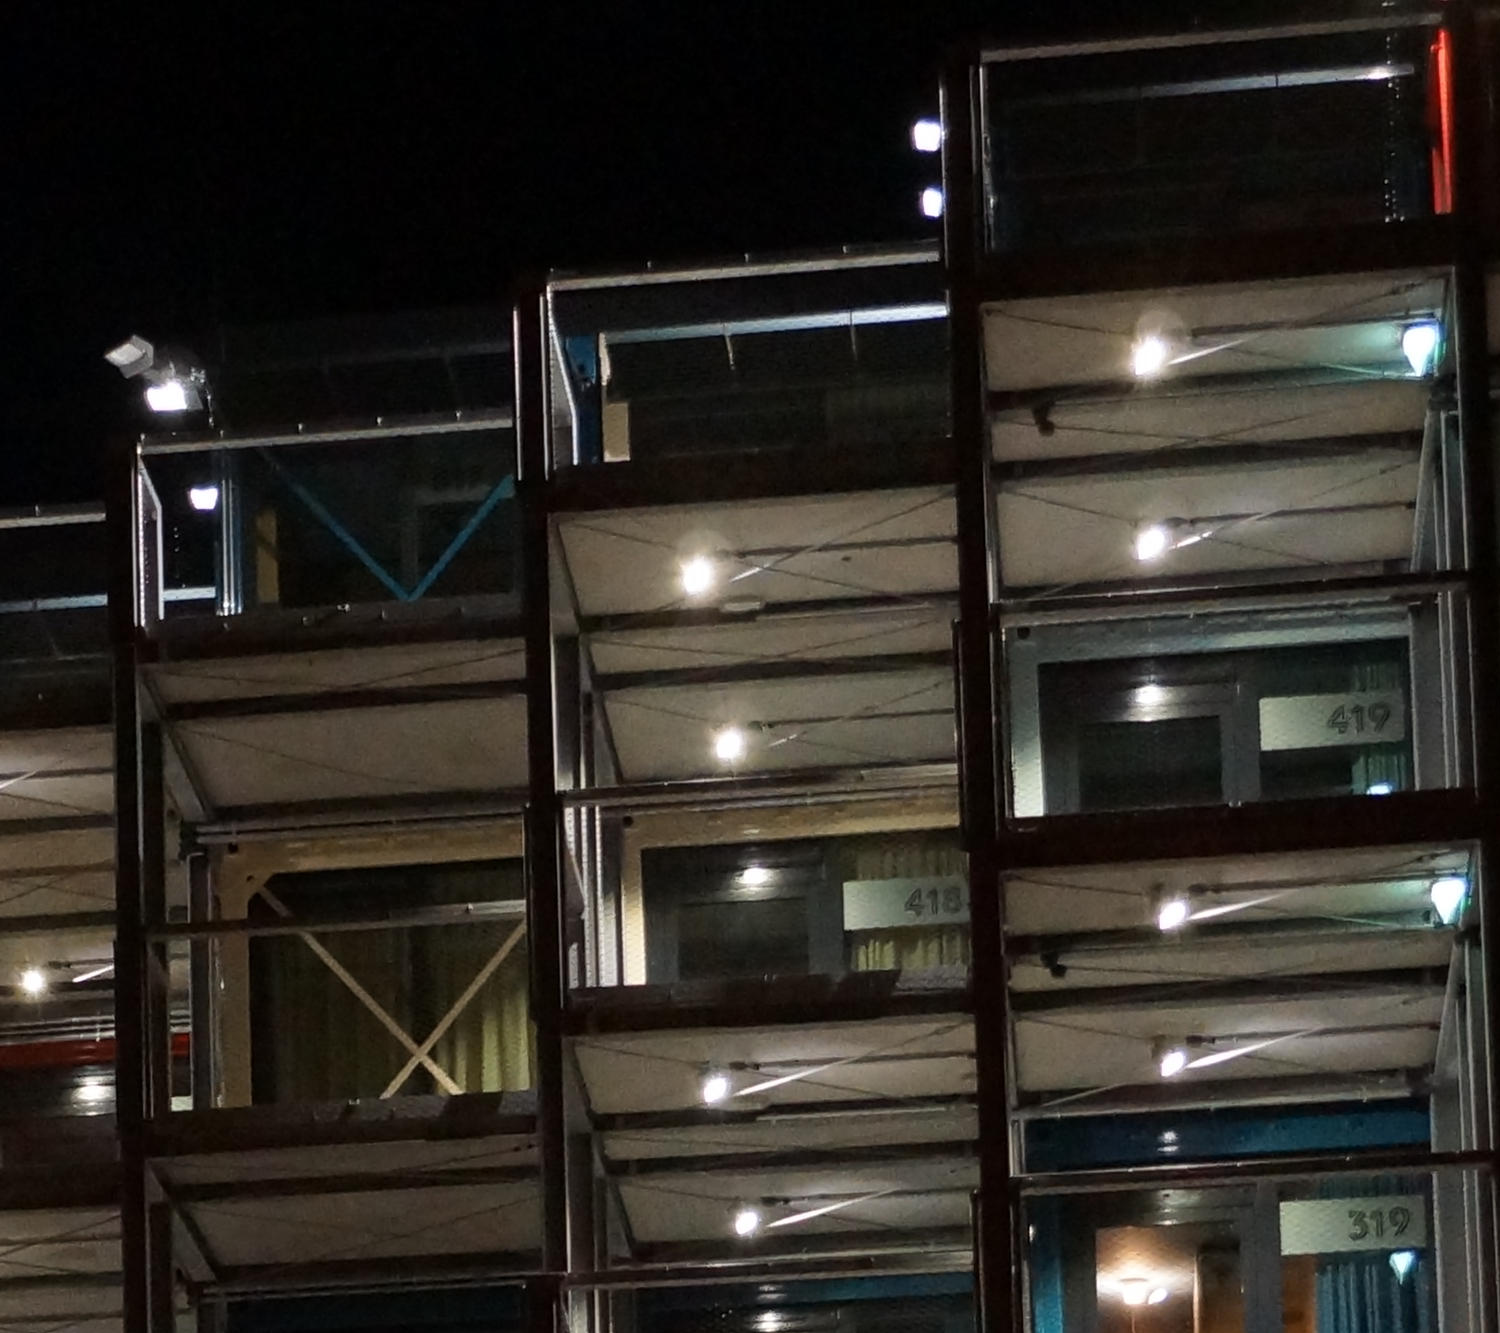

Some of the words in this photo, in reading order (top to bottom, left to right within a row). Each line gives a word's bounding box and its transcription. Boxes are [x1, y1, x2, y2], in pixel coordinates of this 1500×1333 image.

[1326, 702, 1391, 735] 419
[904, 885, 963, 916] 418
[1347, 1206, 1411, 1241] 319
